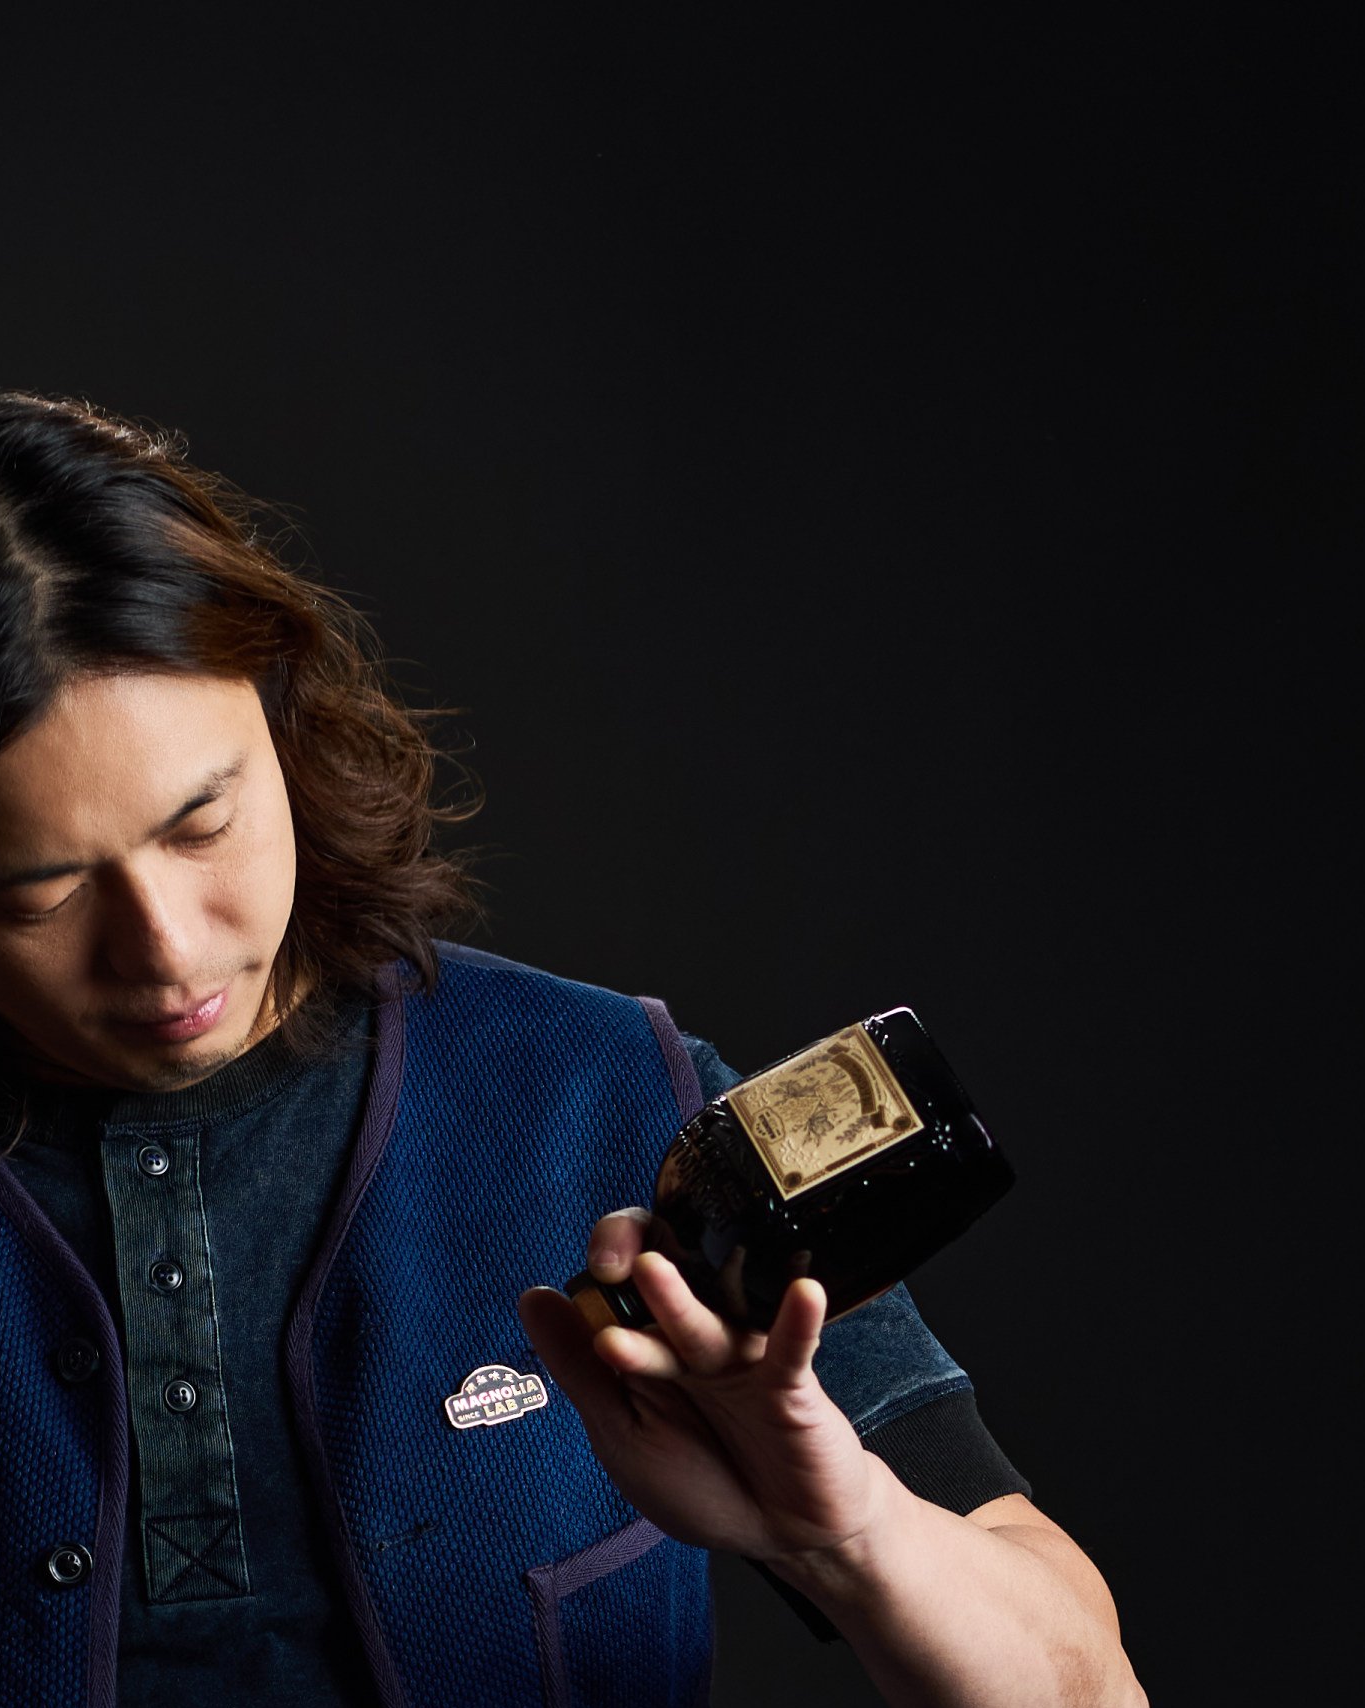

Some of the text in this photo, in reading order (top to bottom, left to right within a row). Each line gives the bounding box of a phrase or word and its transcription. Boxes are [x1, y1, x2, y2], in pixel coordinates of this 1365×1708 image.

[453, 1380, 538, 1412] MAGNOLIA
[457, 1411, 480, 1422] SINCE
[484, 1399, 518, 1417] LAB
